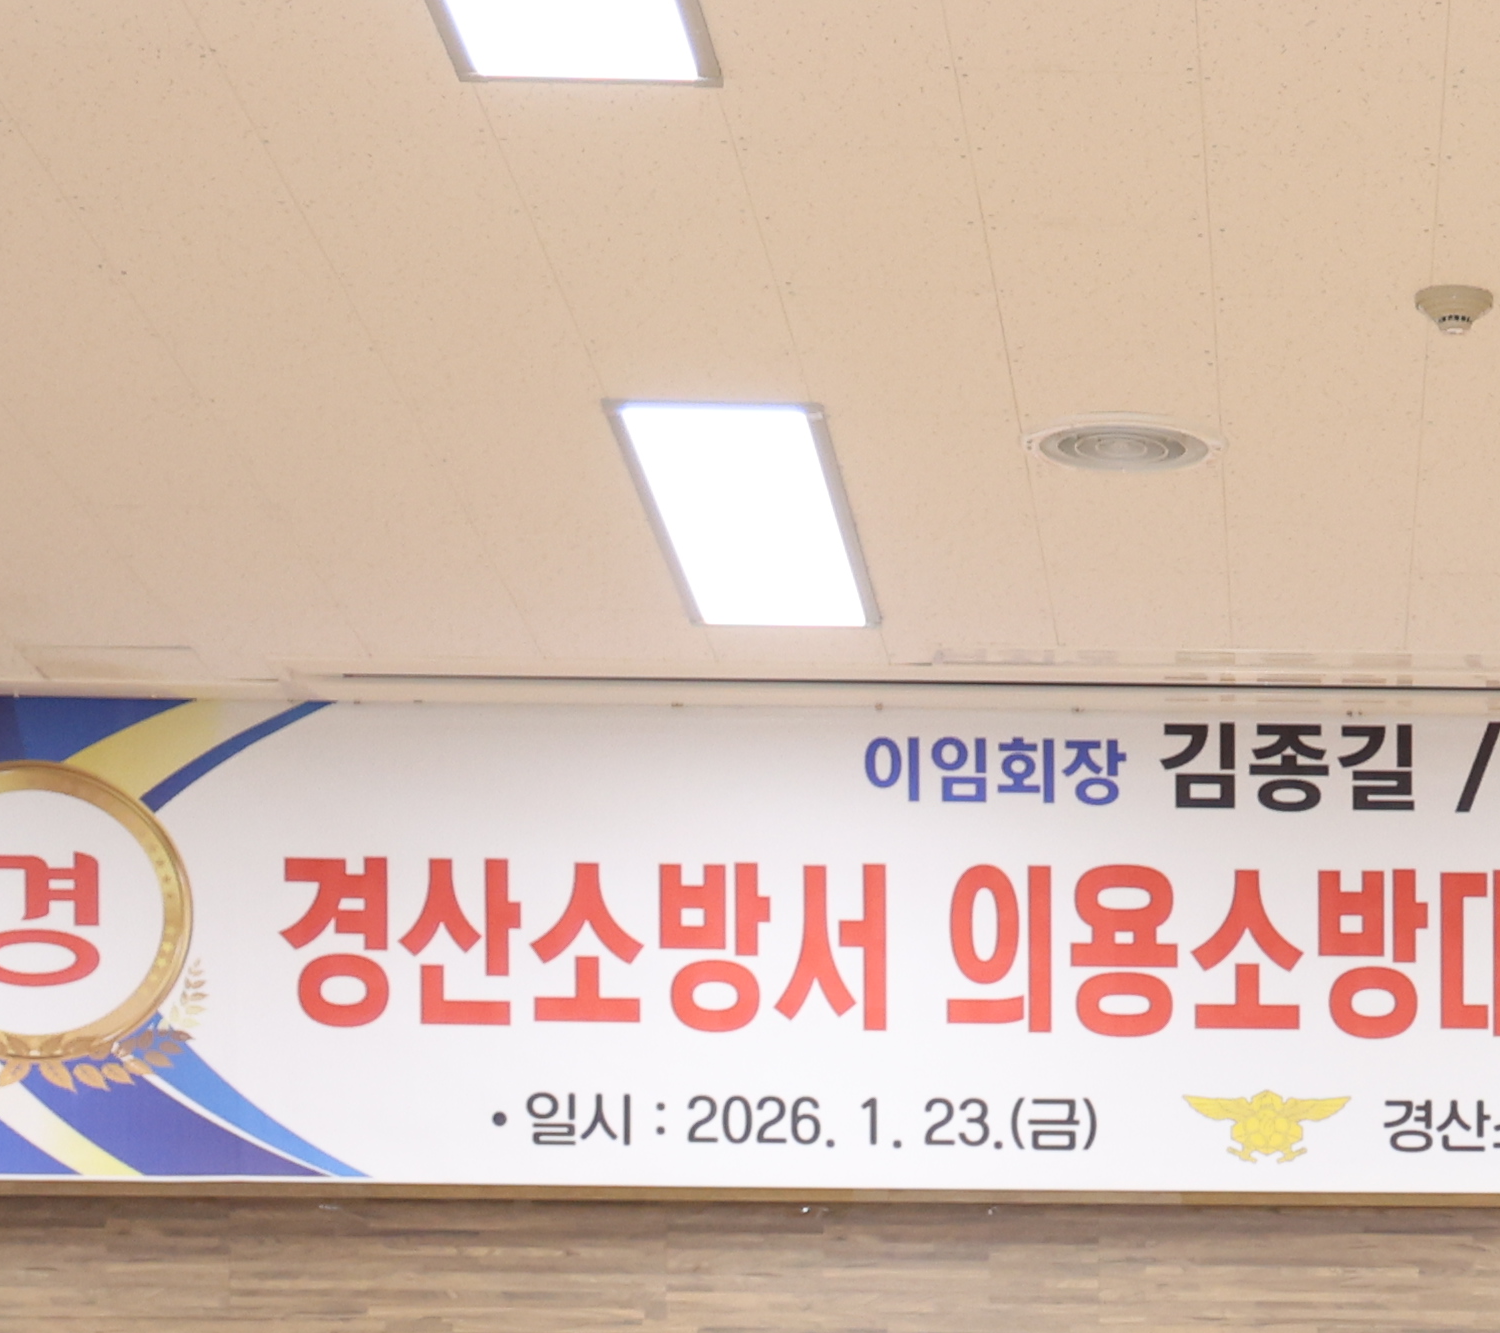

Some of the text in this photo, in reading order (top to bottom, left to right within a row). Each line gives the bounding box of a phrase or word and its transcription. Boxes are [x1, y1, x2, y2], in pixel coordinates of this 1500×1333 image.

[863, 736, 1127, 806] 이임회장
[1160, 722, 1416, 812] 김종길
[279, 855, 887, 1033] 경산소방서
[685, 1094, 836, 1149] 2026.
